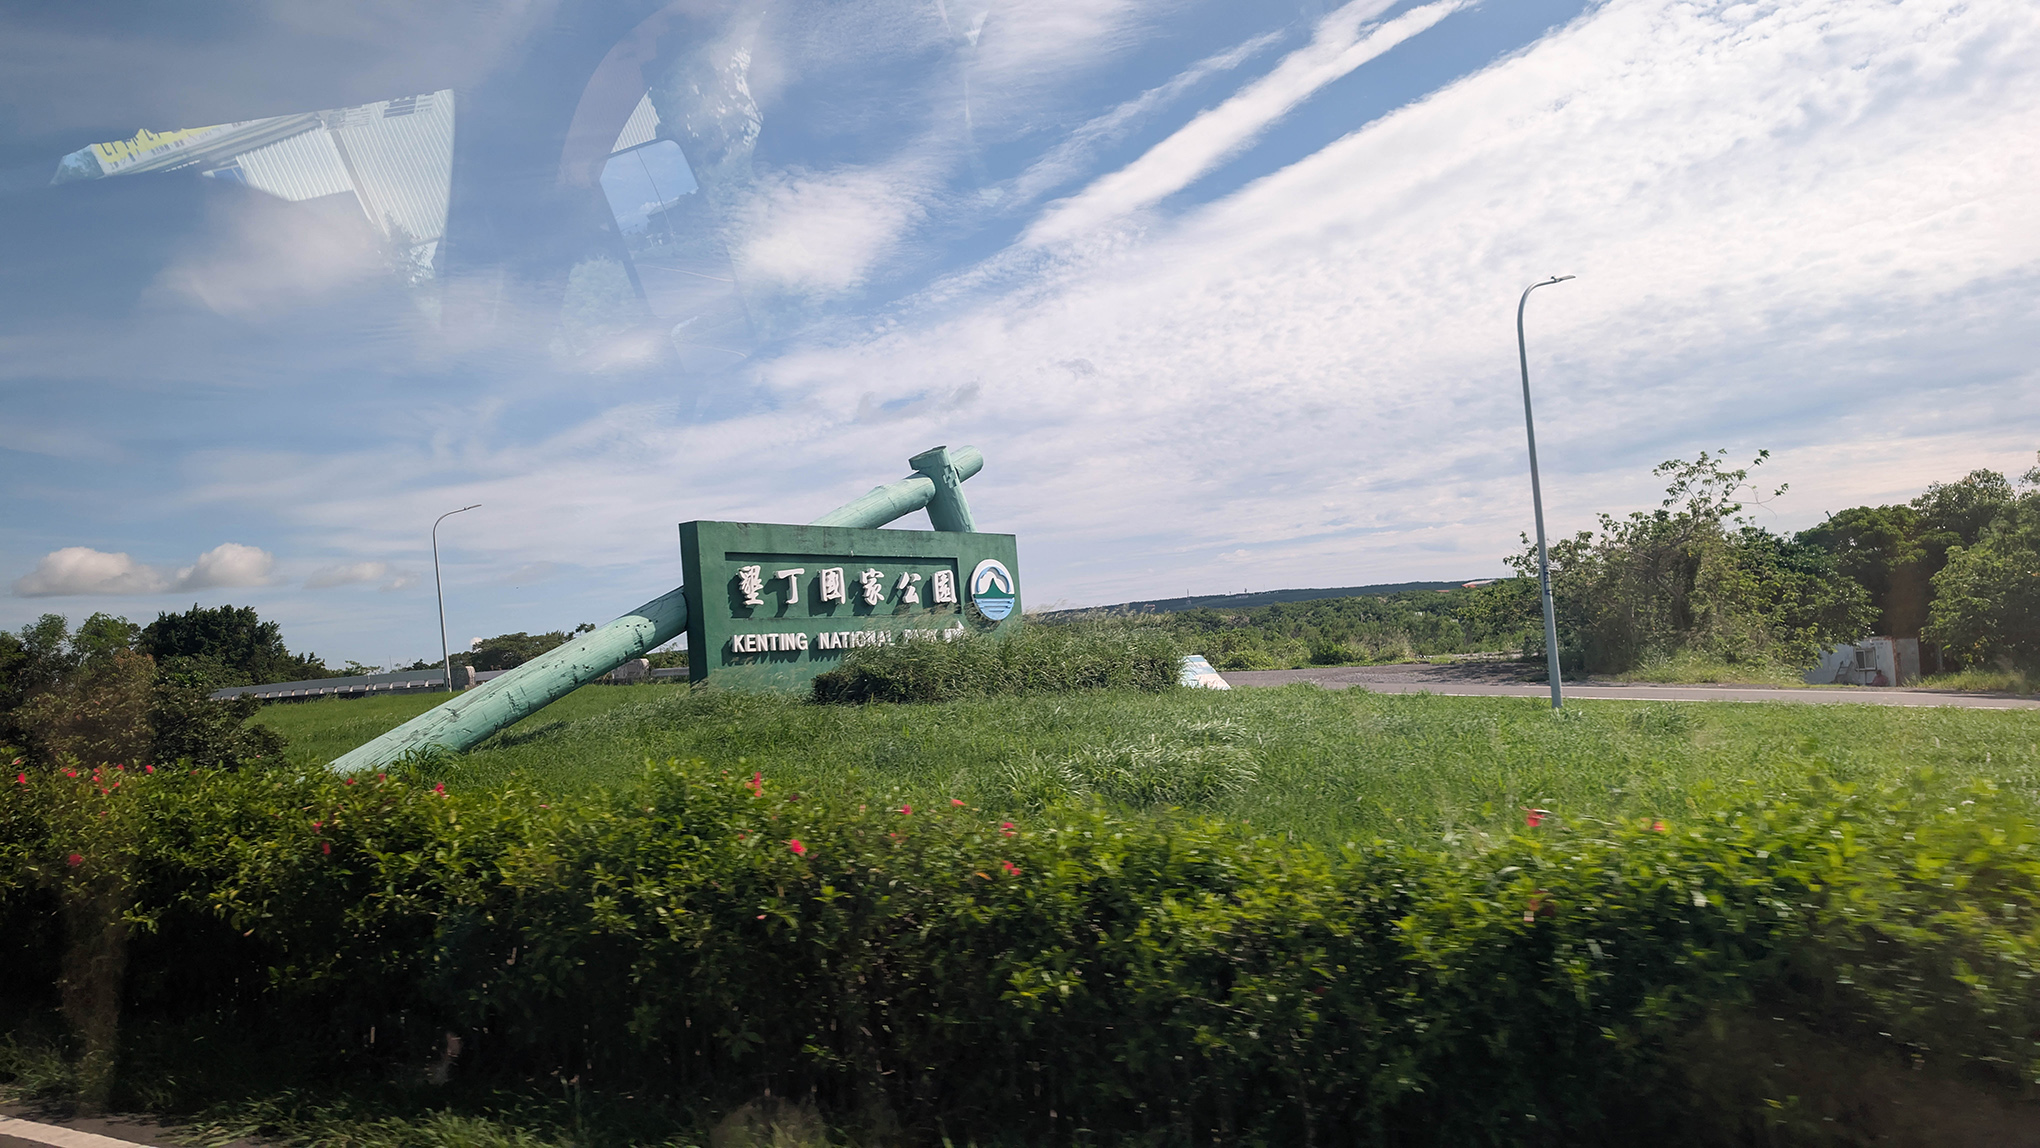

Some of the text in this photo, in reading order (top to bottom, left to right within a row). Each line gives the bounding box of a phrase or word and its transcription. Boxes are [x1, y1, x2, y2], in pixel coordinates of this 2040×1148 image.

[737, 565, 957, 605] 墾丁國家公園
[732, 632, 808, 653] KENTING
[818, 630, 895, 649] NATIONAL
